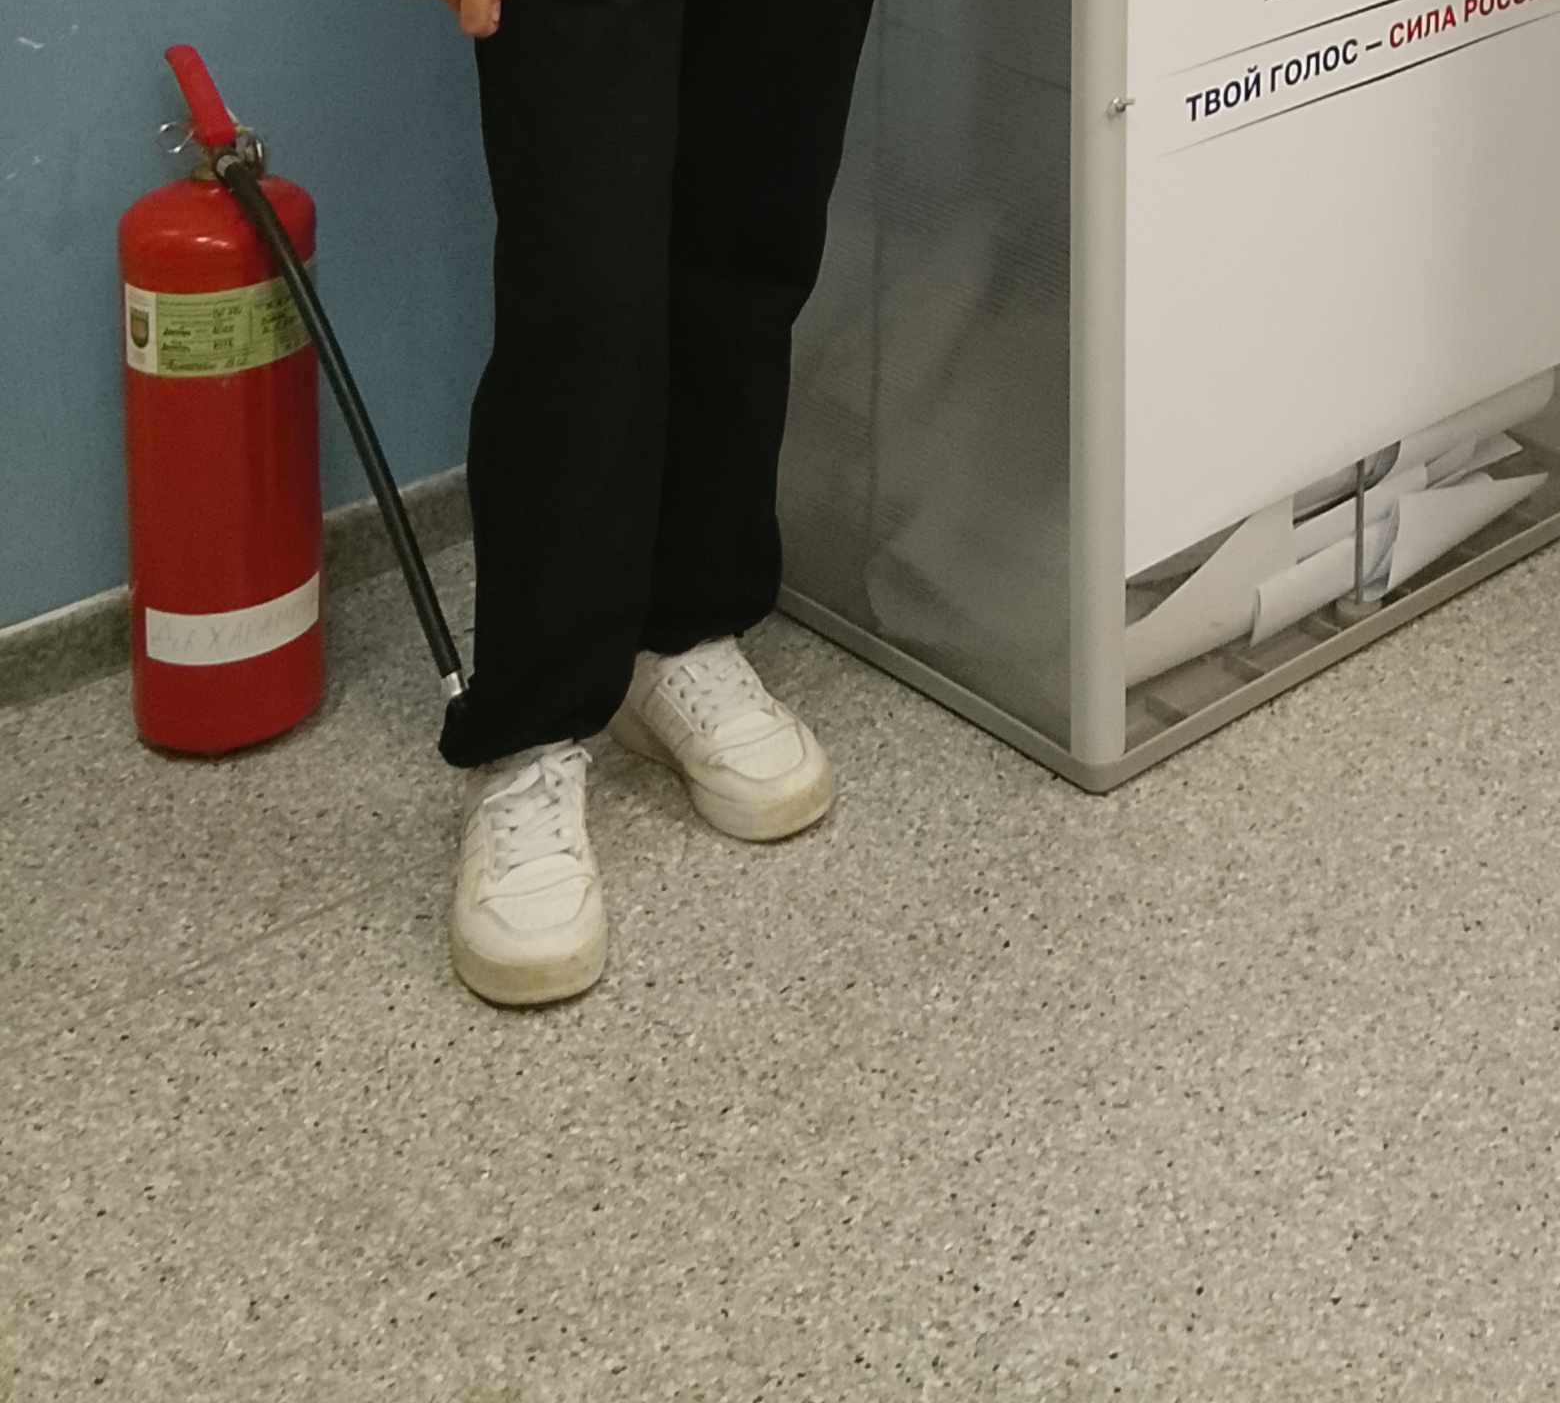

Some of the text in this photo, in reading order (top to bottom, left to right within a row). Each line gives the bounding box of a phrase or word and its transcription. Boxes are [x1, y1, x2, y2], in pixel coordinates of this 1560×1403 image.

[1185, 65, 1262, 122] ТВОЙ
[1269, 38, 1359, 93] ГОЛОС
[1389, 5, 1457, 49] СИЛА
